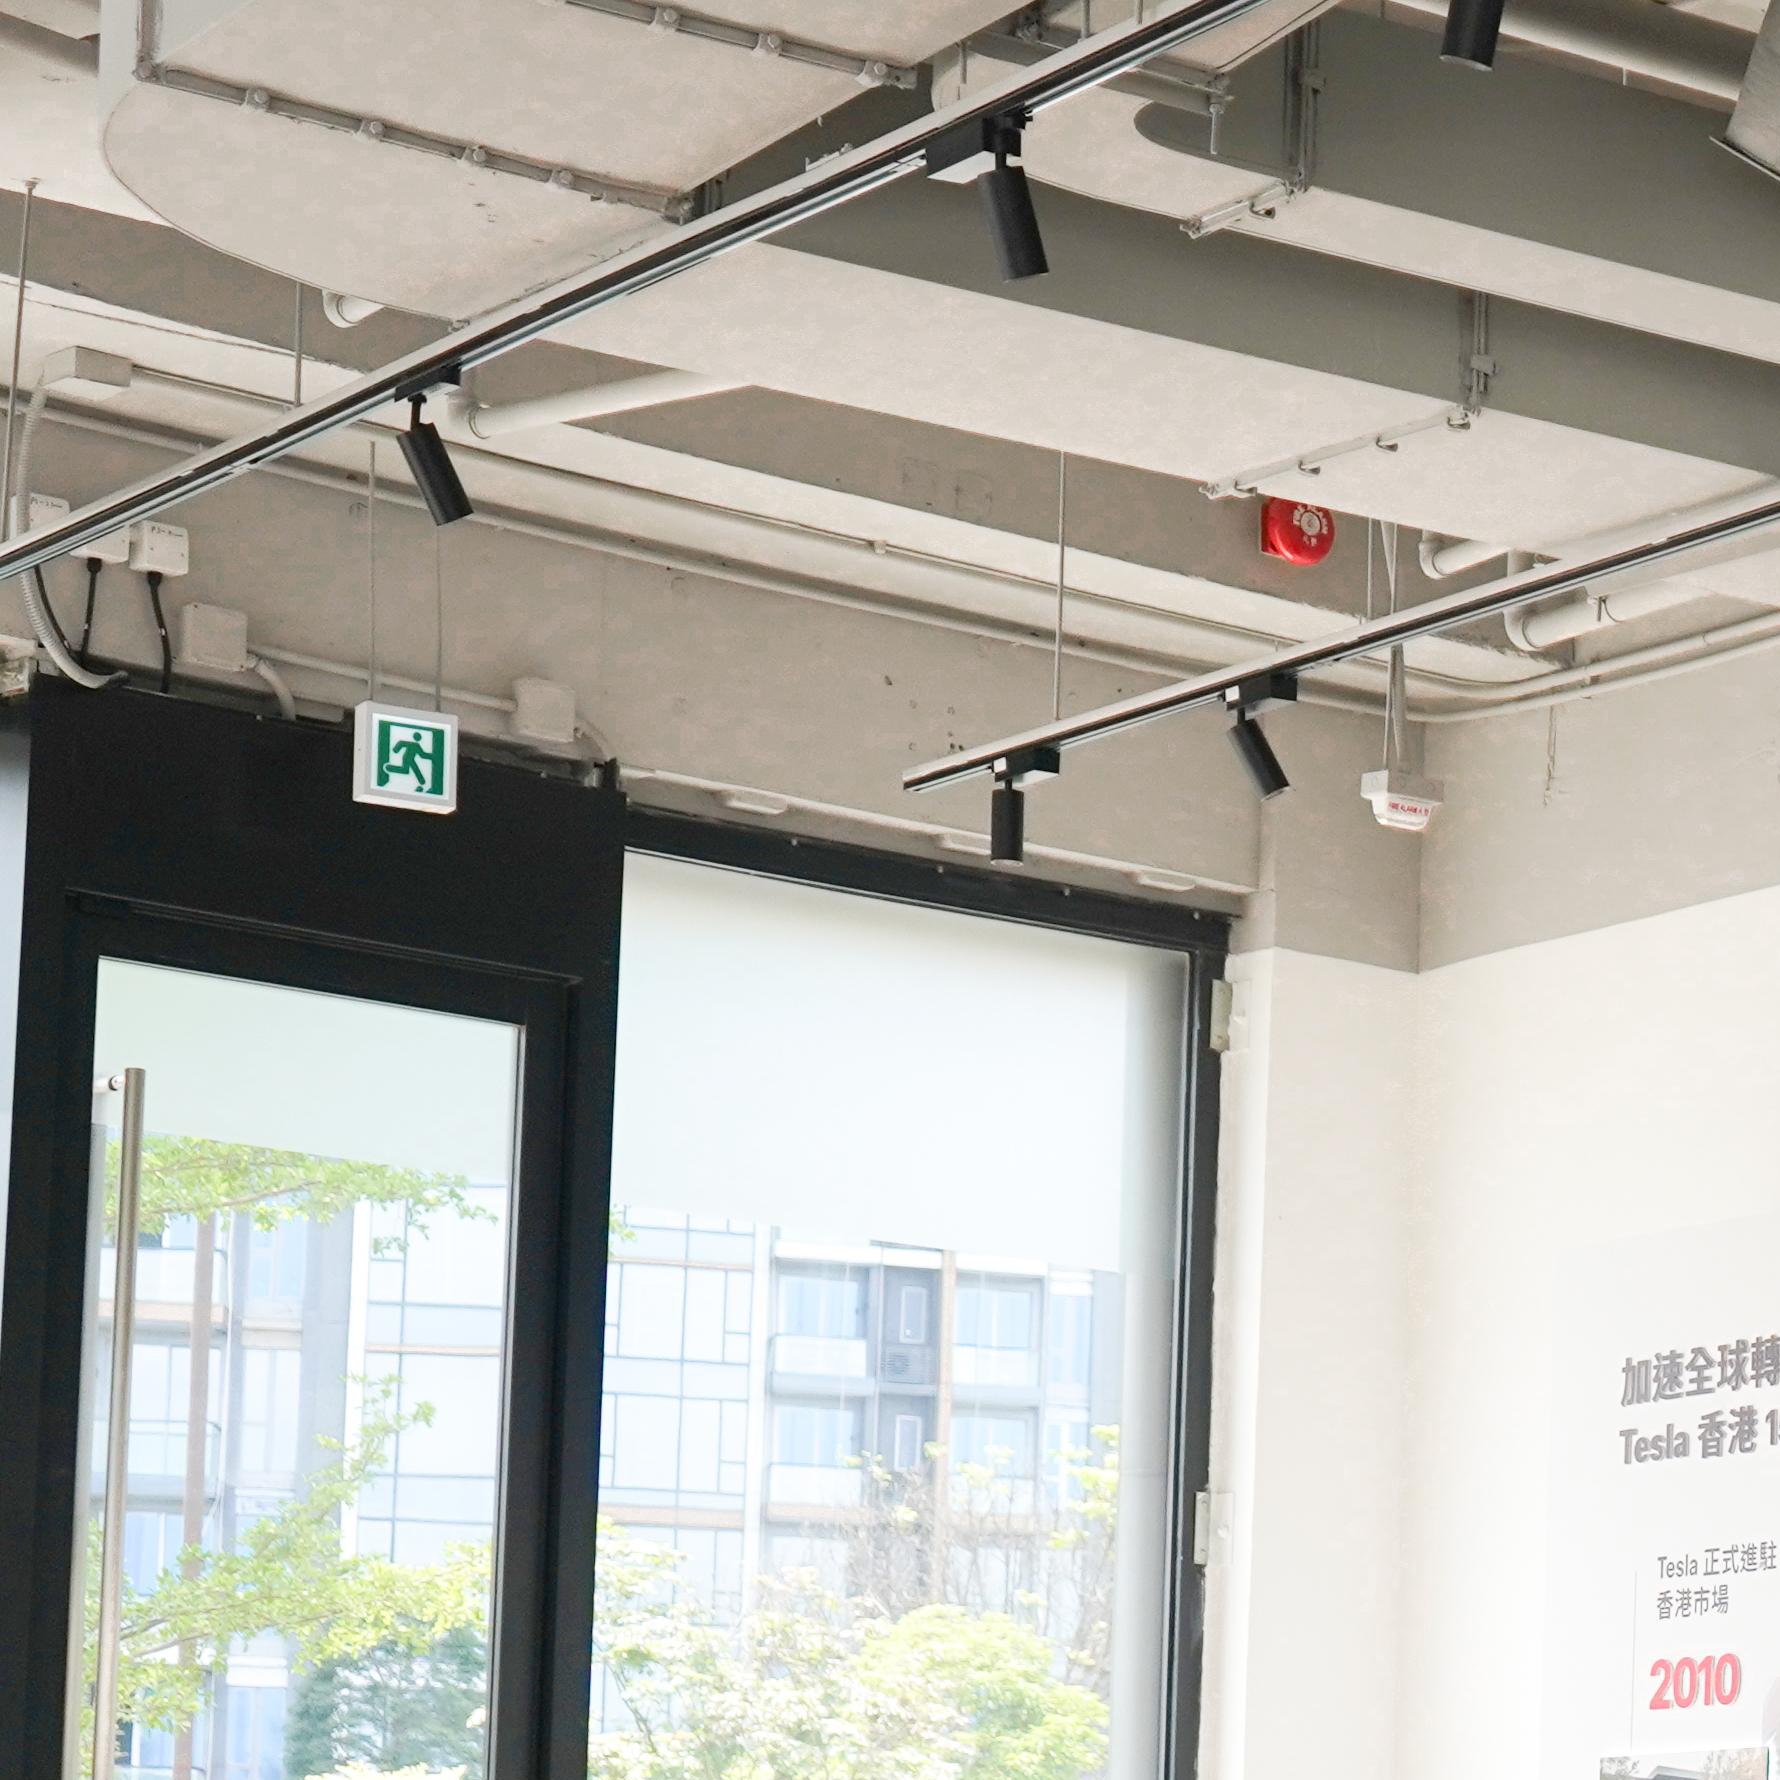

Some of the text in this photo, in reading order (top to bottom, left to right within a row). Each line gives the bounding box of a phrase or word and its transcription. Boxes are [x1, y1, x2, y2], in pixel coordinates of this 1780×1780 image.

[1617, 1423, 1691, 1465] Tesla
[1697, 1405, 1759, 1460] 香港
[1657, 1540, 1778, 1580] Tesla 正式進駐
[1656, 1584, 1730, 1621] 香港市場
[1649, 1653, 1742, 1711] 2010
